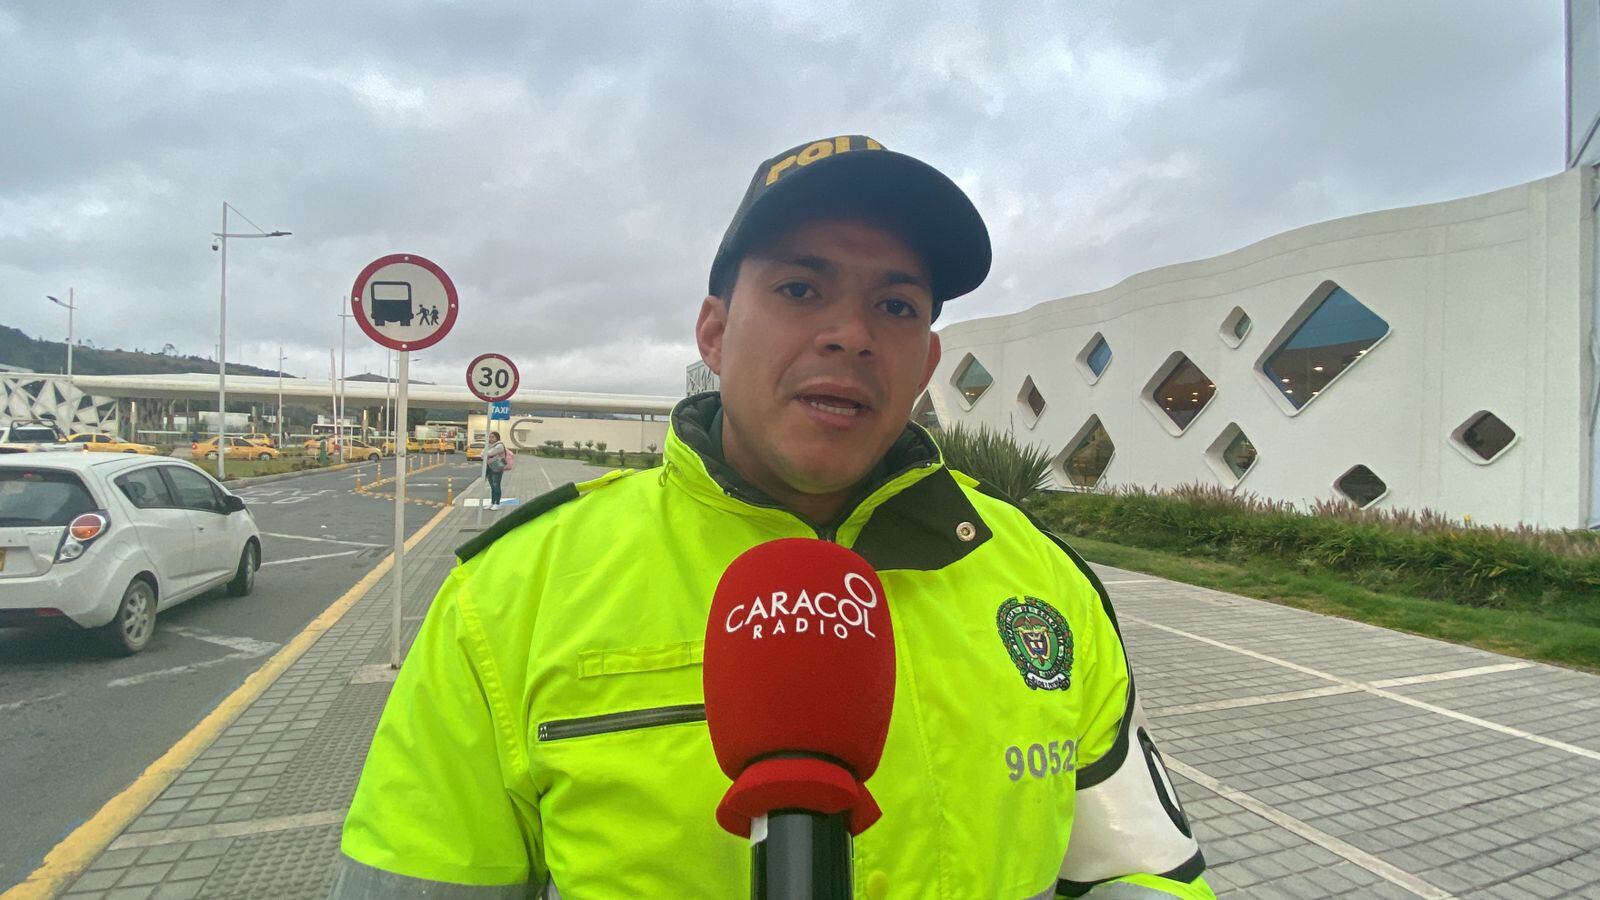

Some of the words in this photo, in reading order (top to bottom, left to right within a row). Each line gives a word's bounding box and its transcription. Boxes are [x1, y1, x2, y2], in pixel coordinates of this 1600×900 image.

[478, 366, 510, 389] 30
[491, 405, 509, 415] TAXI
[725, 572, 877, 638] CARACOL
[752, 617, 849, 640] RADIO
